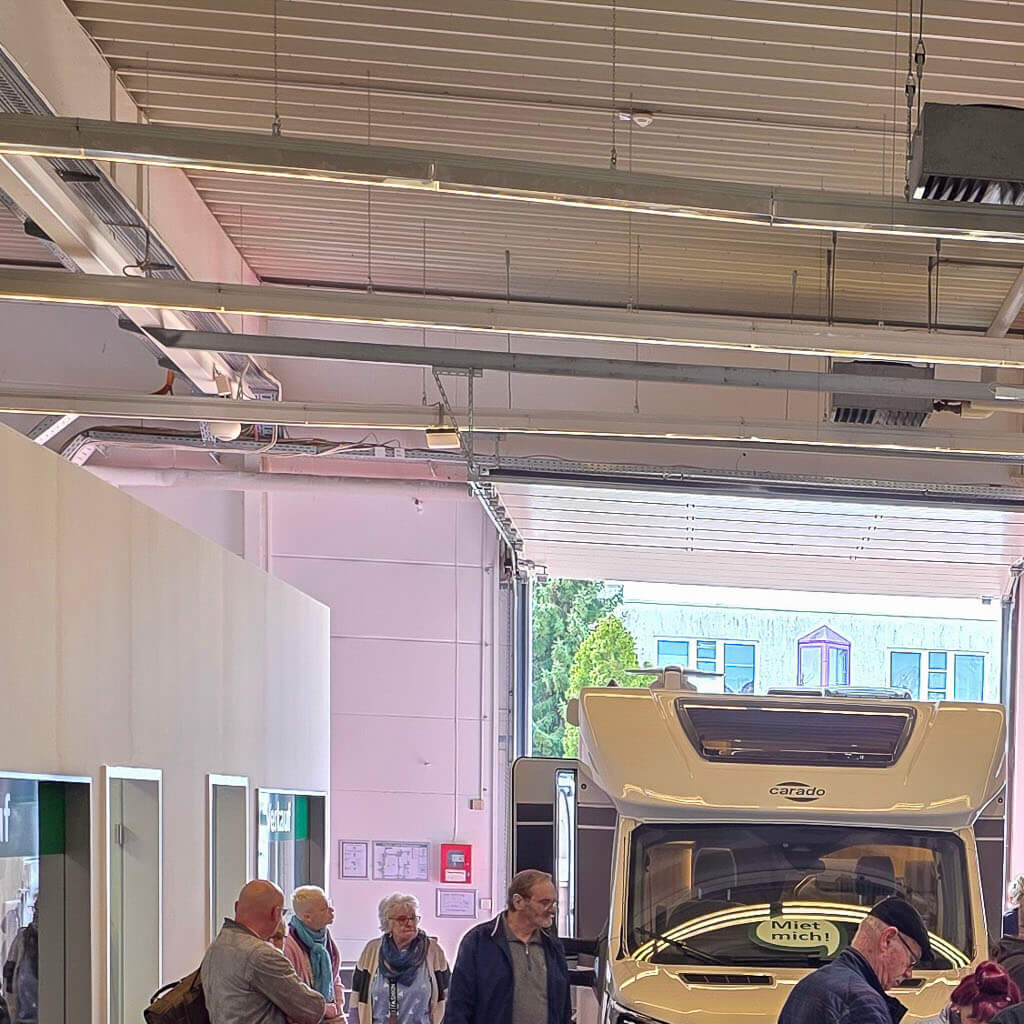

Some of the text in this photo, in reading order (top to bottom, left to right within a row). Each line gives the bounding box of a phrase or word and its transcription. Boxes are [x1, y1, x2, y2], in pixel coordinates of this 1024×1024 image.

[769, 786, 826, 797] carado
[771, 919, 821, 930] Miet
[771, 931, 830, 942] mich!
